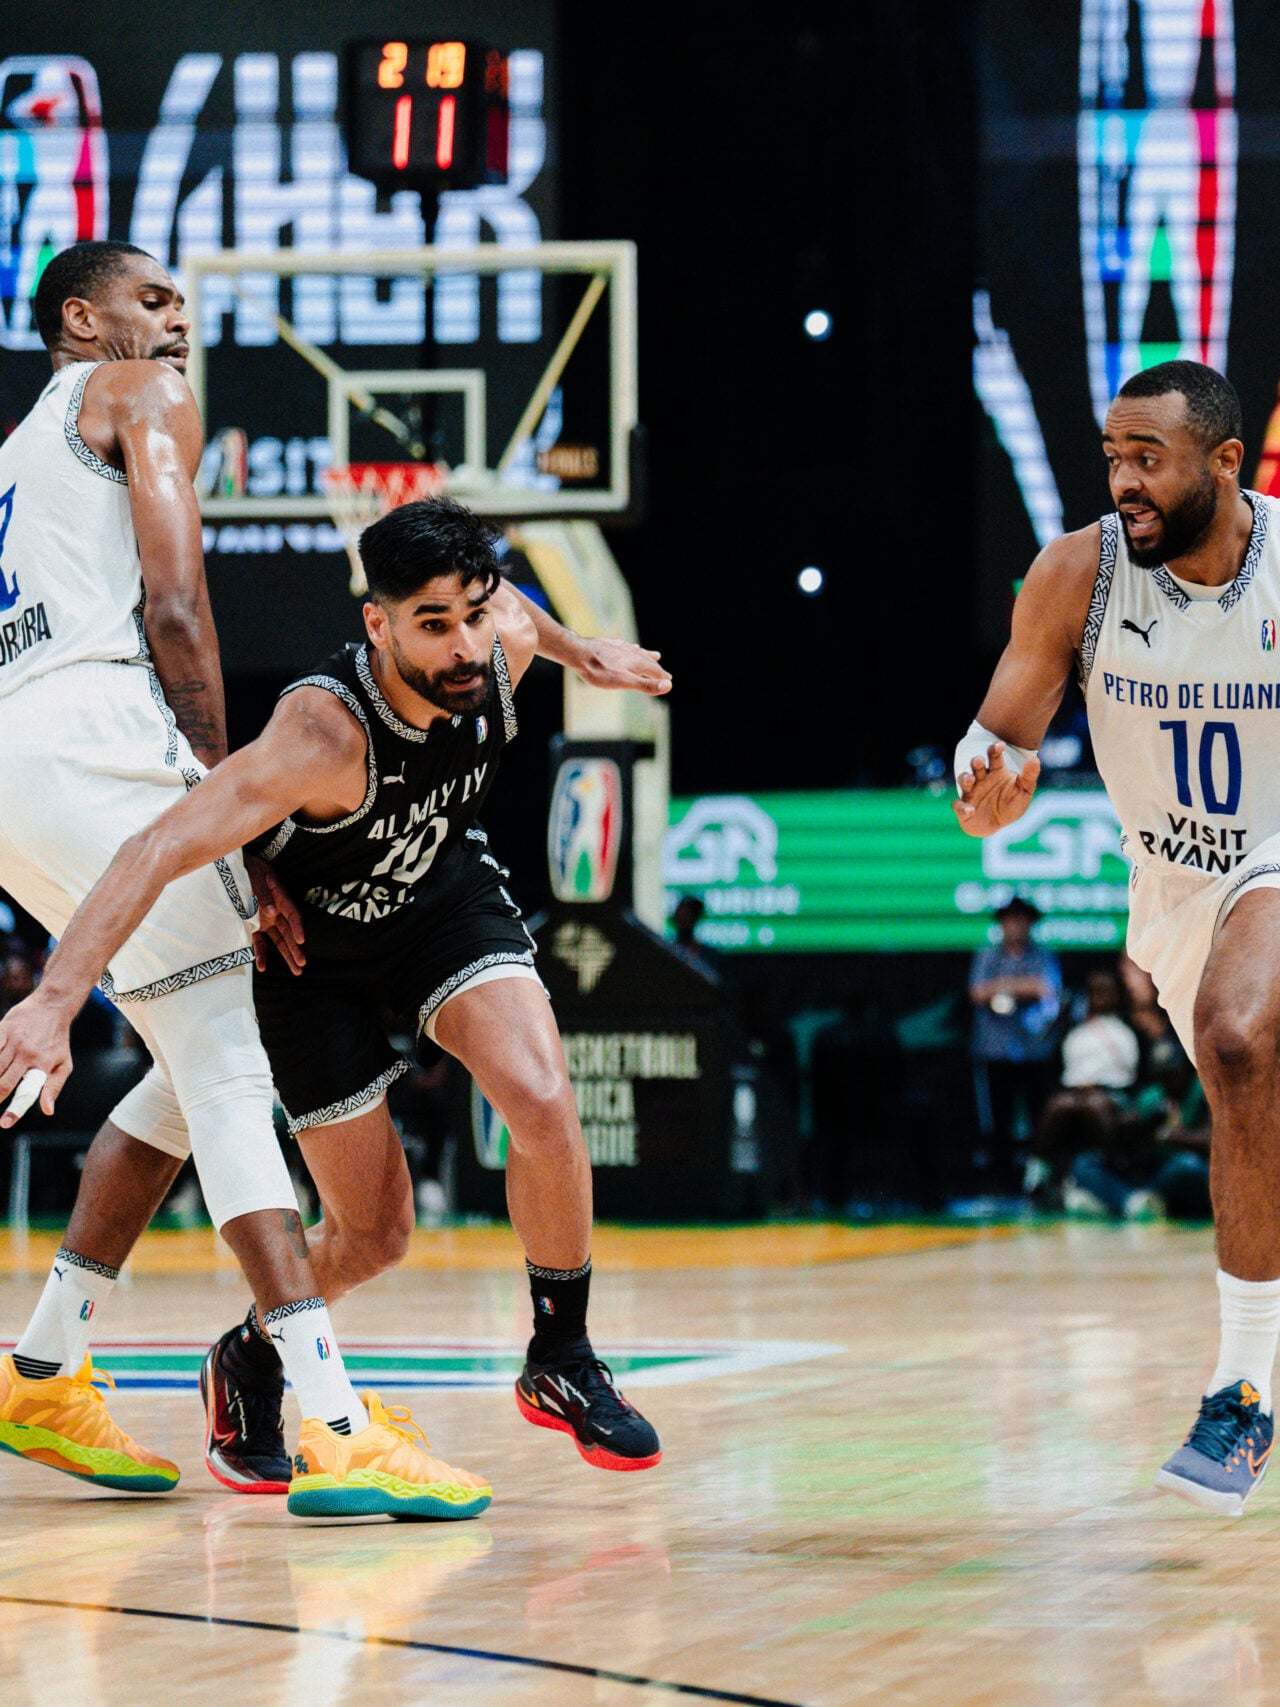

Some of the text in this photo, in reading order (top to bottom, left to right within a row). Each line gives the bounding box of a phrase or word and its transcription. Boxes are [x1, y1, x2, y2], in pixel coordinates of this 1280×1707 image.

[392, 94, 456, 170] 11
[1103, 672, 1169, 709] PETRO
[1178, 683, 1205, 709] DE
[367, 814, 399, 840] AL
[461, 762, 488, 803] LY
[1159, 720, 1242, 816] 10
[371, 816, 449, 885] 10
[1138, 830, 1248, 875] RWAN
[1166, 811, 1247, 850] VISIT
